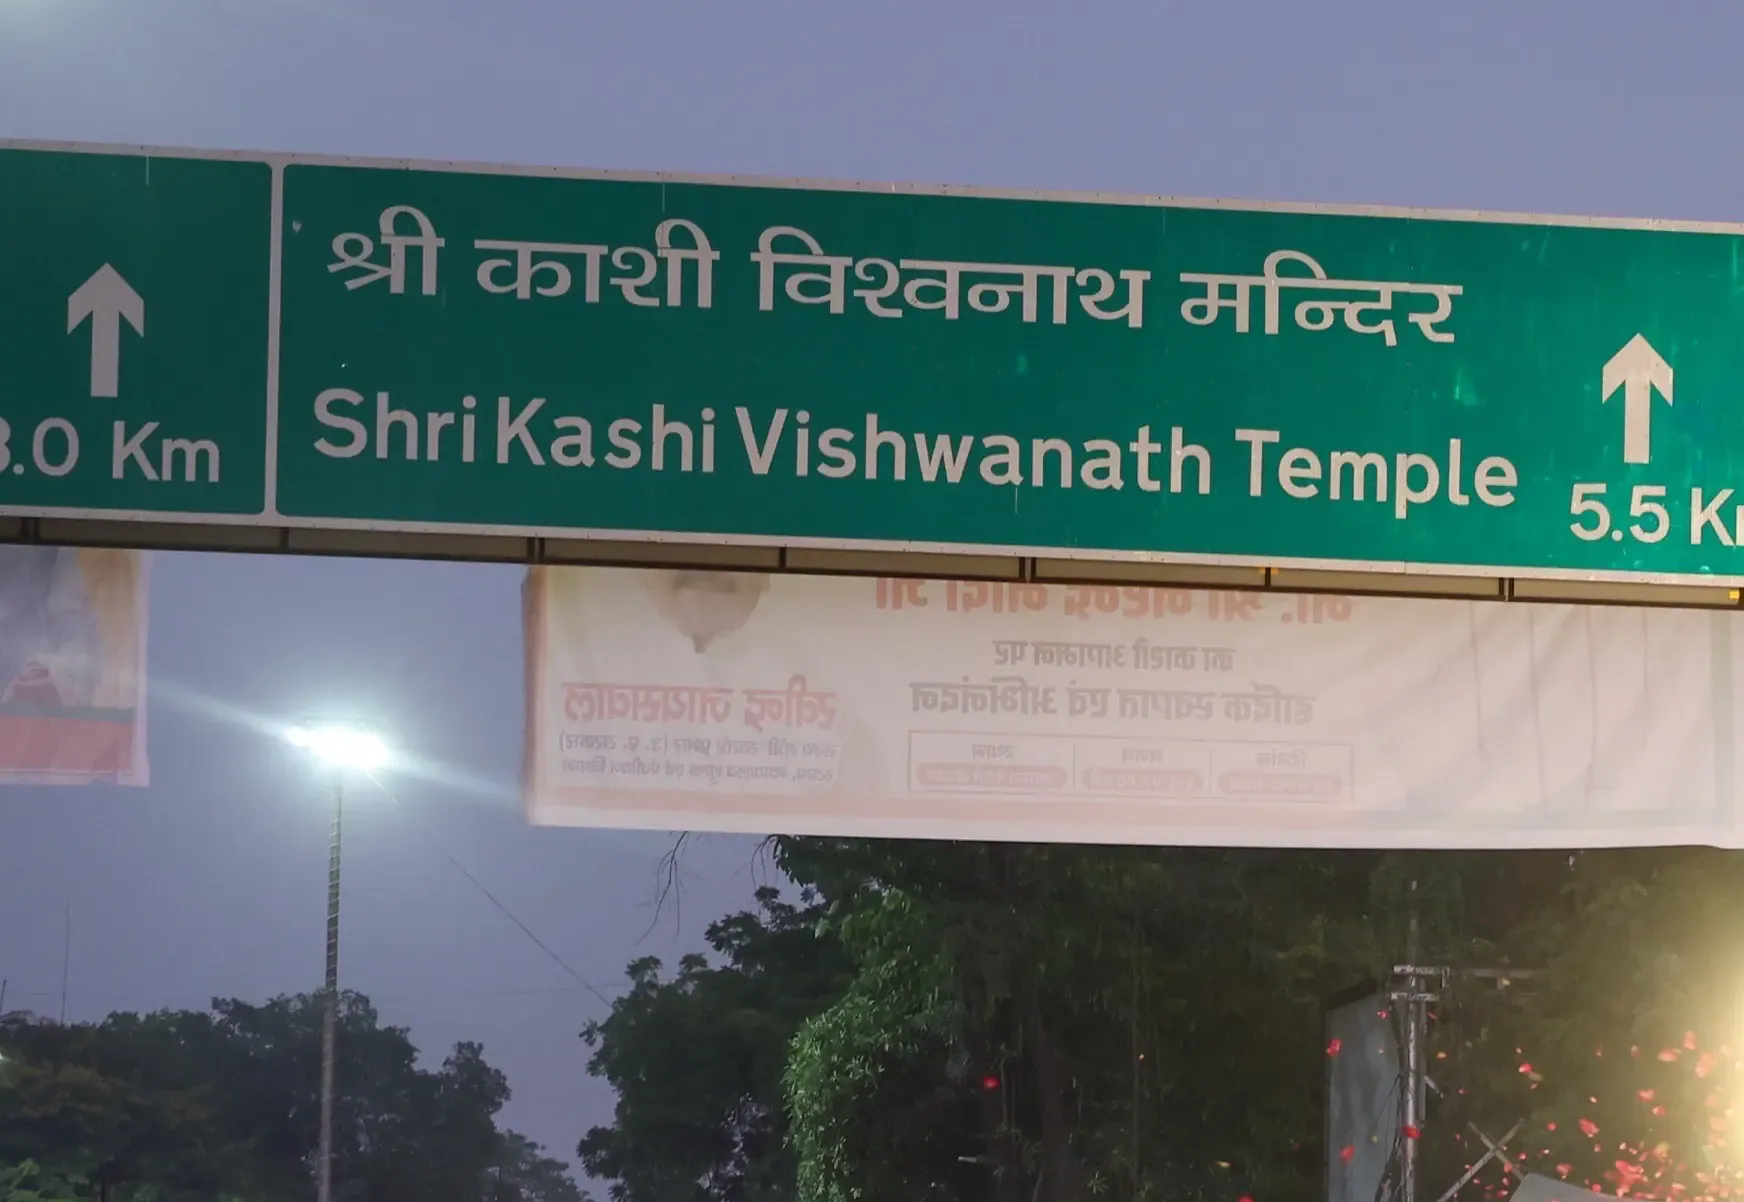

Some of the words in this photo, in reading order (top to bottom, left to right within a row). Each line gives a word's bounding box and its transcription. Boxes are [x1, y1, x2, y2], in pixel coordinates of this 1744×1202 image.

[328, 206, 445, 295] श्री
[475, 219, 720, 308] काशी
[751, 226, 1151, 328] विश्वनाथ
[1180, 250, 1463, 346] मन्दिर
[0, 416, 80, 476] .0
[113, 421, 219, 482] Km
[314, 389, 476, 462] Shri
[497, 397, 714, 472] Kashi
[735, 407, 1210, 494] Vishwanath
[1235, 429, 1517, 519] Temple
[1570, 483, 1670, 543] 5.5
